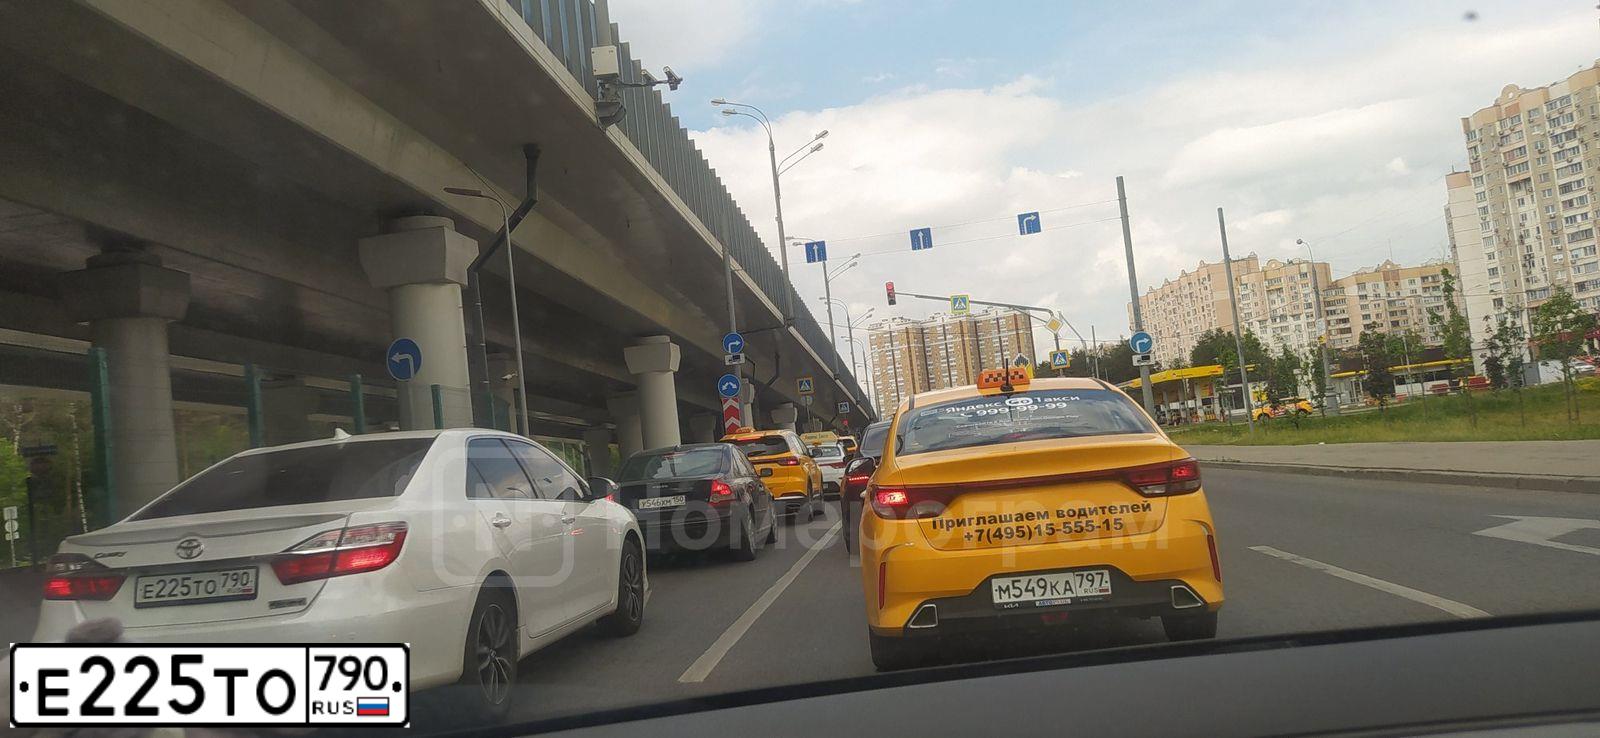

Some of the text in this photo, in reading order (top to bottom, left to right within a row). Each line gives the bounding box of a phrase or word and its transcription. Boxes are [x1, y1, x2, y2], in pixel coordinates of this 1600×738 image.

[945, 401, 1003, 414] Яндекс
[976, 402, 1067, 416] 999-99-99
[932, 500, 1152, 531] Приглашаем водителей
[964, 517, 1124, 544] +7(495)15-555-15
[143, 571, 251, 600] Е225ТО 790
[997, 572, 1105, 600] М549КА 797
